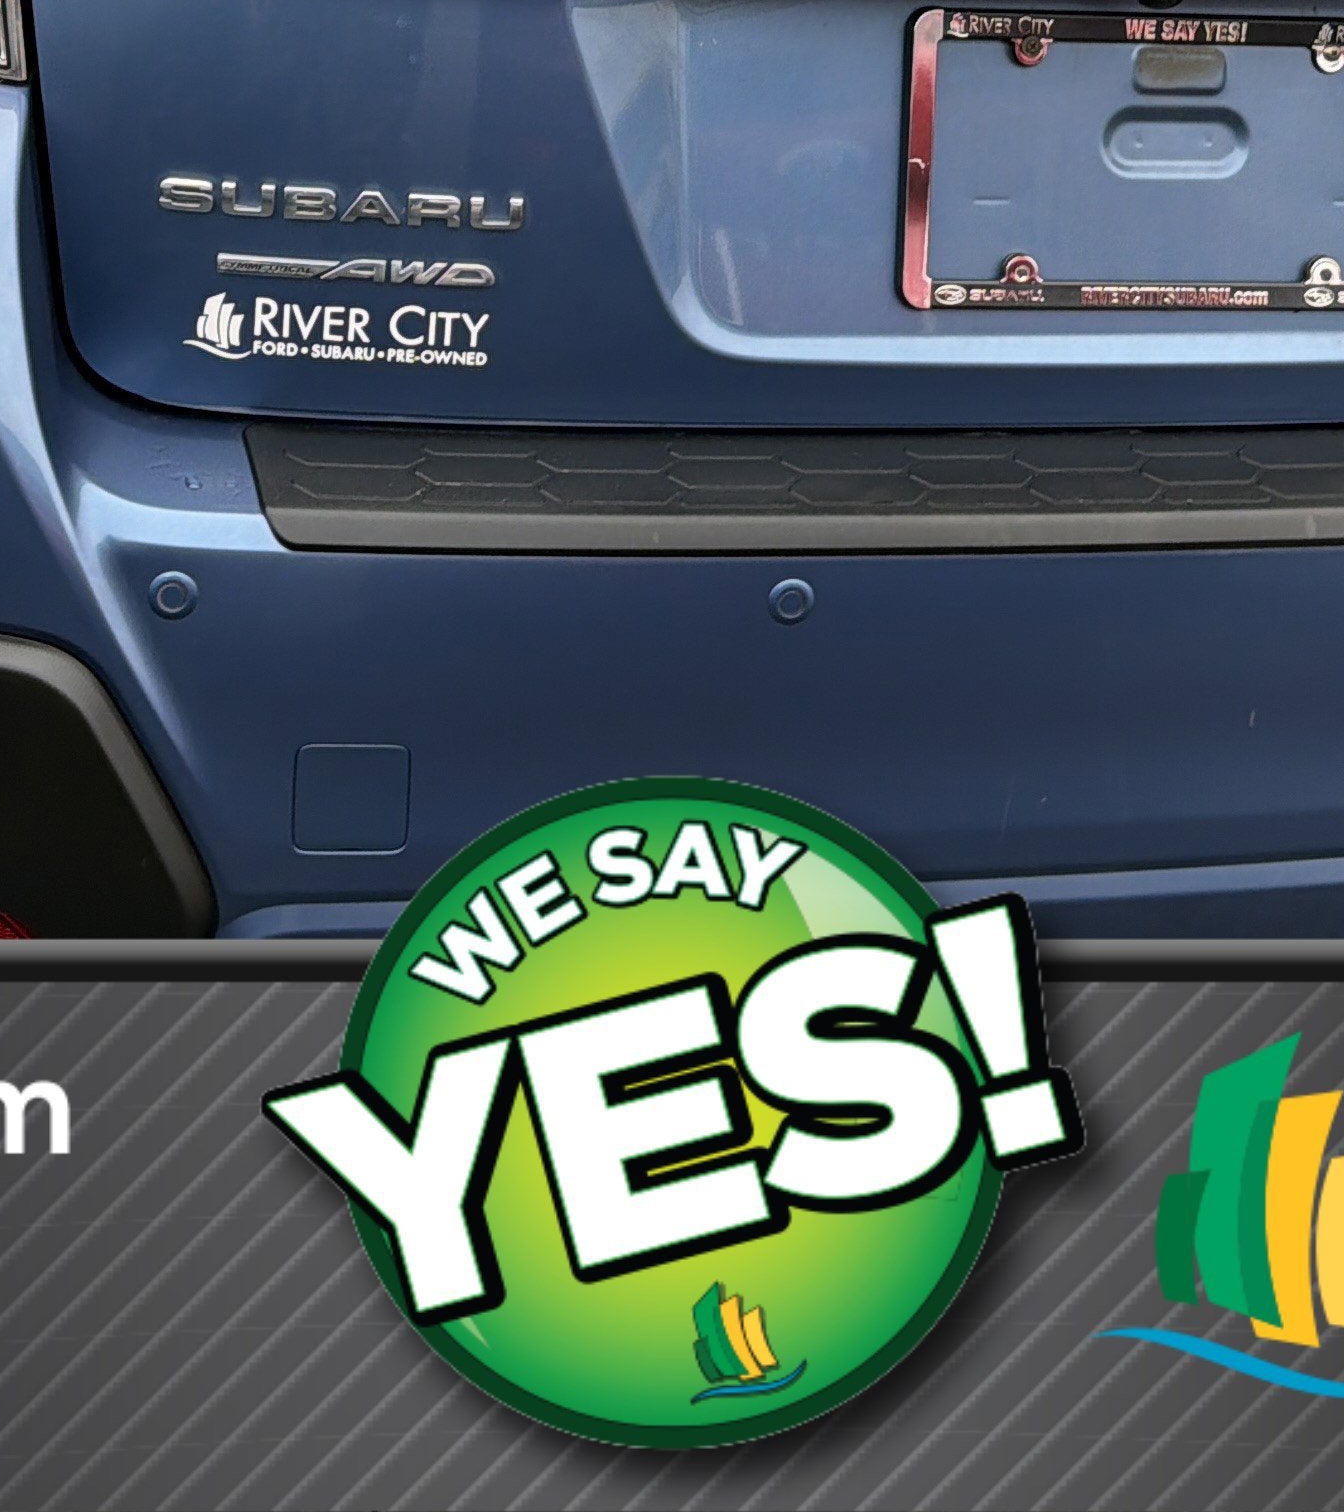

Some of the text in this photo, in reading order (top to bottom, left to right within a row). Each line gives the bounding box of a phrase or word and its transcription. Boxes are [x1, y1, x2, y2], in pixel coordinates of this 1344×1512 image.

[968, 15, 1055, 37] RIVER CITY
[1125, 18, 1248, 43] WE SAY YES!
[158, 175, 525, 230] SUBARU
[320, 258, 496, 286] AWD
[253, 296, 490, 348] RIVER CITY
[252, 340, 488, 367] FORD SUBARU PRE-OWNED
